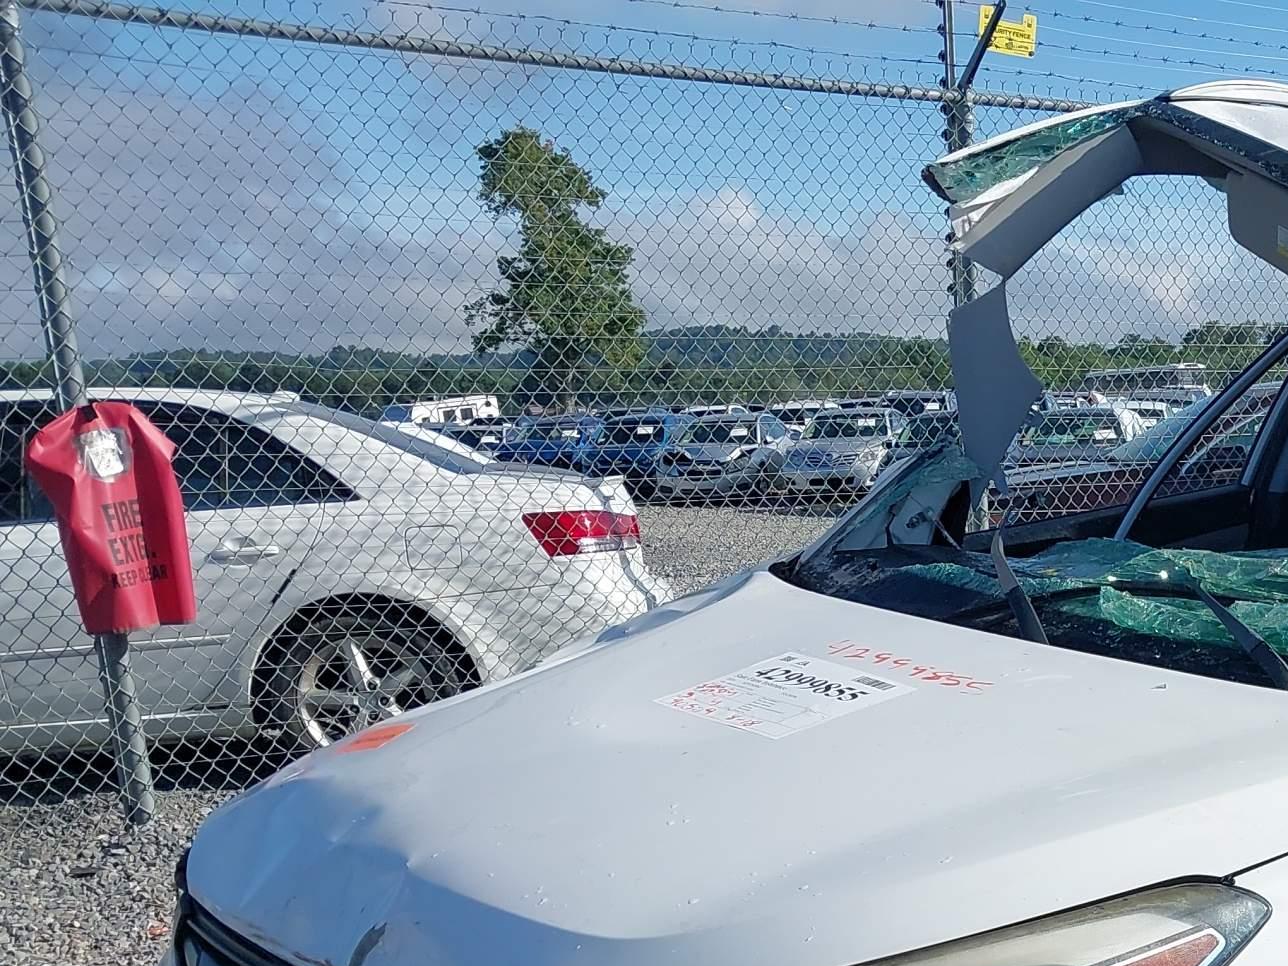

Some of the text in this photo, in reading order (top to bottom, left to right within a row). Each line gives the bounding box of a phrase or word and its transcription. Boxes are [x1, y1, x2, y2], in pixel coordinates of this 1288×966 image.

[102, 499, 144, 532] FIRE
[111, 569, 138, 589] KEEP
[755, 667, 870, 701] 42999855
